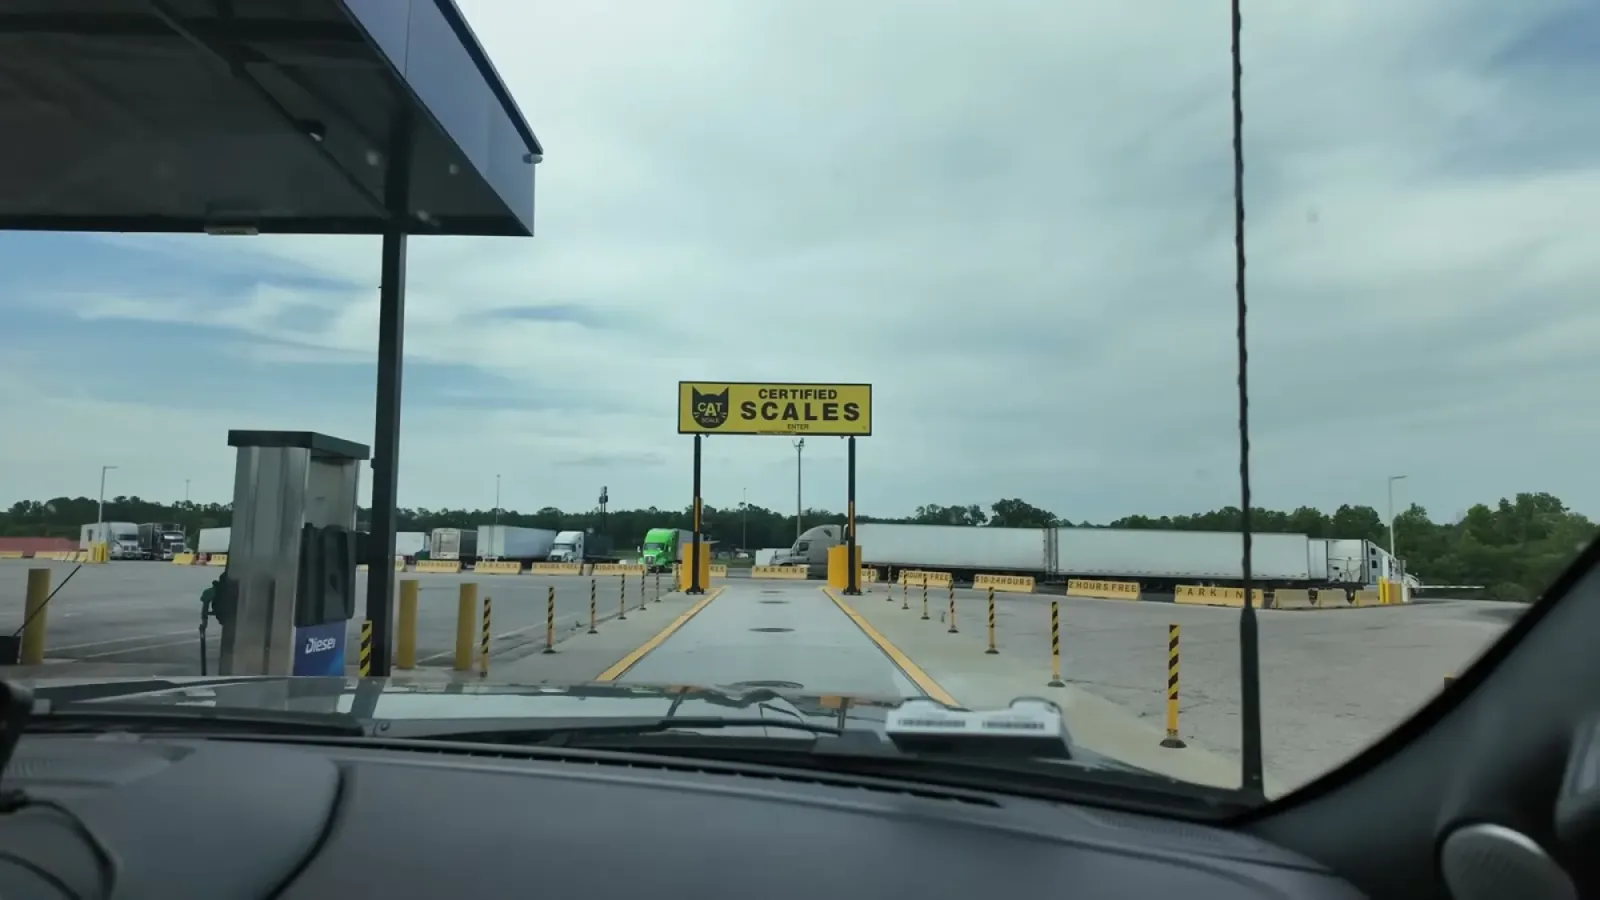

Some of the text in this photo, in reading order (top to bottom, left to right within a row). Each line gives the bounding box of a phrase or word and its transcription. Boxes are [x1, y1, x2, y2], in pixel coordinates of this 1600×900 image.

[758, 388, 838, 400] CERTIFIED
[697, 402, 723, 417] CAT
[740, 401, 860, 421] SCALES
[930, 573, 949, 581] FREE
[1076, 581, 1109, 591] HOURS
[1111, 584, 1137, 592] FREE
[304, 637, 336, 654] Diesel
